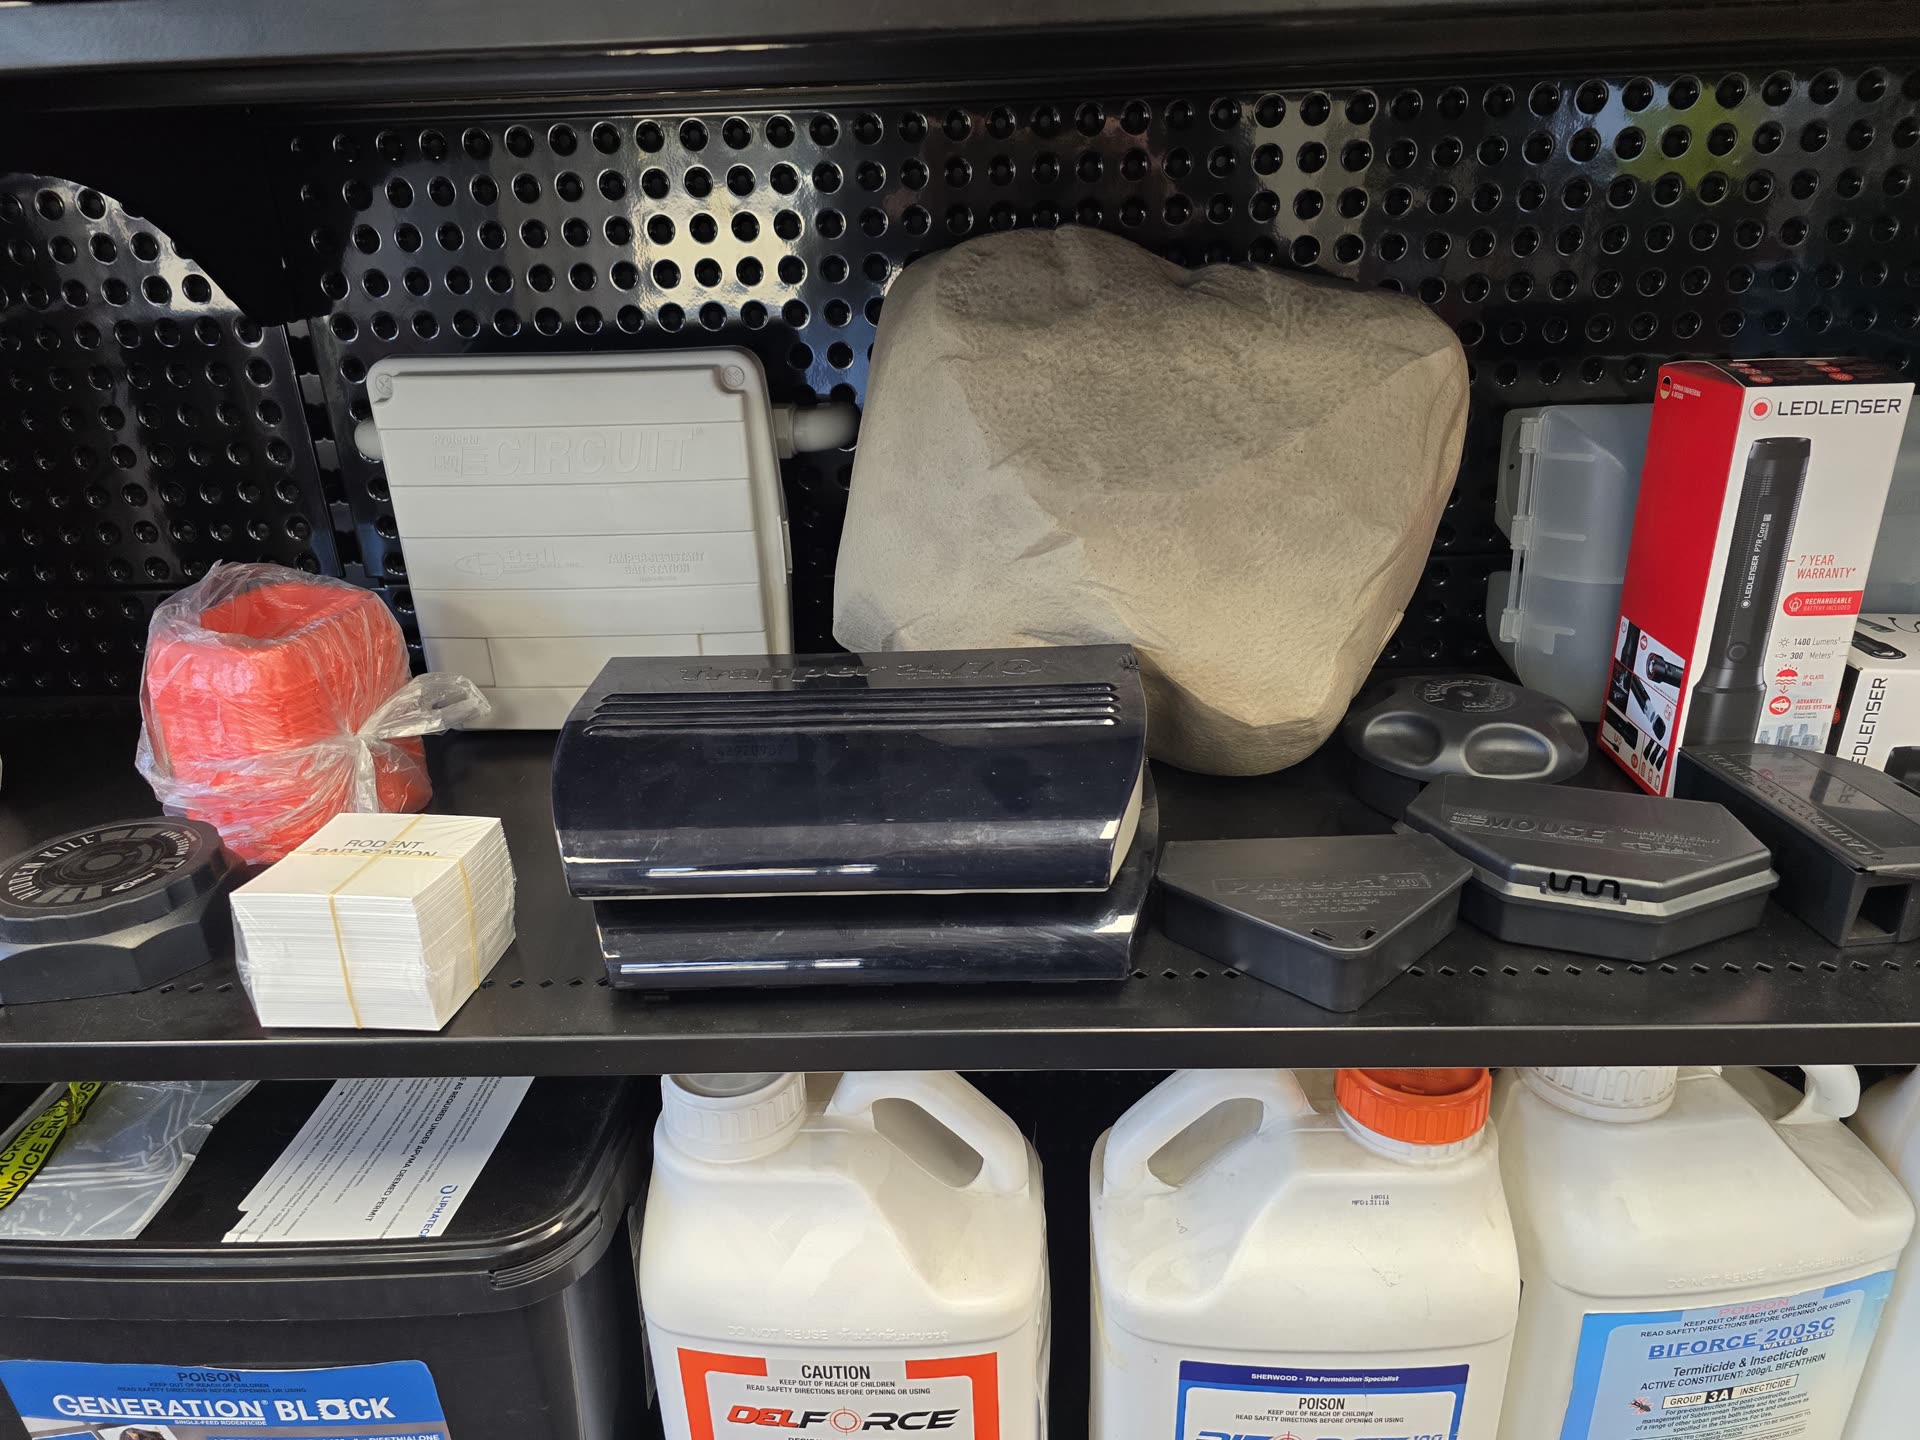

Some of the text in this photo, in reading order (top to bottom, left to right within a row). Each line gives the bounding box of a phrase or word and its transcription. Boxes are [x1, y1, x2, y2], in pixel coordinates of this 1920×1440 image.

[1778, 399, 1902, 416] LEDLENSER
[608, 551, 705, 565] TAMPER-RESISTANT
[648, 563, 690, 575] STATION
[1744, 522, 1766, 599] LEDLENSER P7R Core
[1800, 554, 1834, 566] 7 YEAR
[1804, 597, 1852, 605] RECHARGEABLE
[1851, 677, 1888, 764] EDLENSER
[1484, 816, 1607, 842] MOUSE
[344, 840, 424, 849] RODENT
[8, 862, 46, 900] HIDDEN
[0, 1121, 46, 1176] ACKING
[364, 1082, 464, 1222] AS REQUIRED UNDER APVMA DEEMED PERMIT
[1666, 1326, 1698, 1336] SAFETY
[1698, 1320, 1748, 1332] DIRECTIONS
[1749, 1315, 1779, 1326] BEFORE
[1780, 1308, 1816, 1320] OPENING
[1817, 1304, 1828, 1312] OR
[1829, 1298, 1852, 1310] USING
[1684, 1319, 1706, 1328] KEEP
[1739, 1312, 1768, 1322] REACH
[1780, 1301, 1818, 1315] CHILDREN
[1718, 1298, 1790, 1317] POISON
[728, 1326, 745, 1336] DO
[752, 1327, 780, 1338] NOT
[784, 1328, 829, 1340] REUSE
[1648, 1316, 1836, 1358] BIFORCE 200SC
[1762, 1330, 1834, 1350] WATER-BASED
[802, 1365, 870, 1380] CAUTION
[1640, 1353, 1826, 1390] ACTIVE CONSTITUENT: 200g/L BIFENTHRIN
[1674, 1346, 1808, 1377] Termiticide & Insecticide
[178, 1372, 242, 1382] POISON
[1251, 1374, 1298, 1382] SHERWOOD
[1670, 1378, 1792, 1406] GROUP 3A INSECTICIDE
[1677, 1390, 1790, 1415] pre-construction post-construction
[52, 1394, 397, 1422] GENERATION BLOCK
[1298, 1398, 1346, 1410] POISON
[1642, 1416, 1683, 1424] management
[1690, 1408, 1730, 1419] Subterranean
[1731, 1404, 1755, 1412] Termites
[727, 1404, 960, 1432] DELFORCE
[1673, 1416, 1748, 1433] specified Directions
